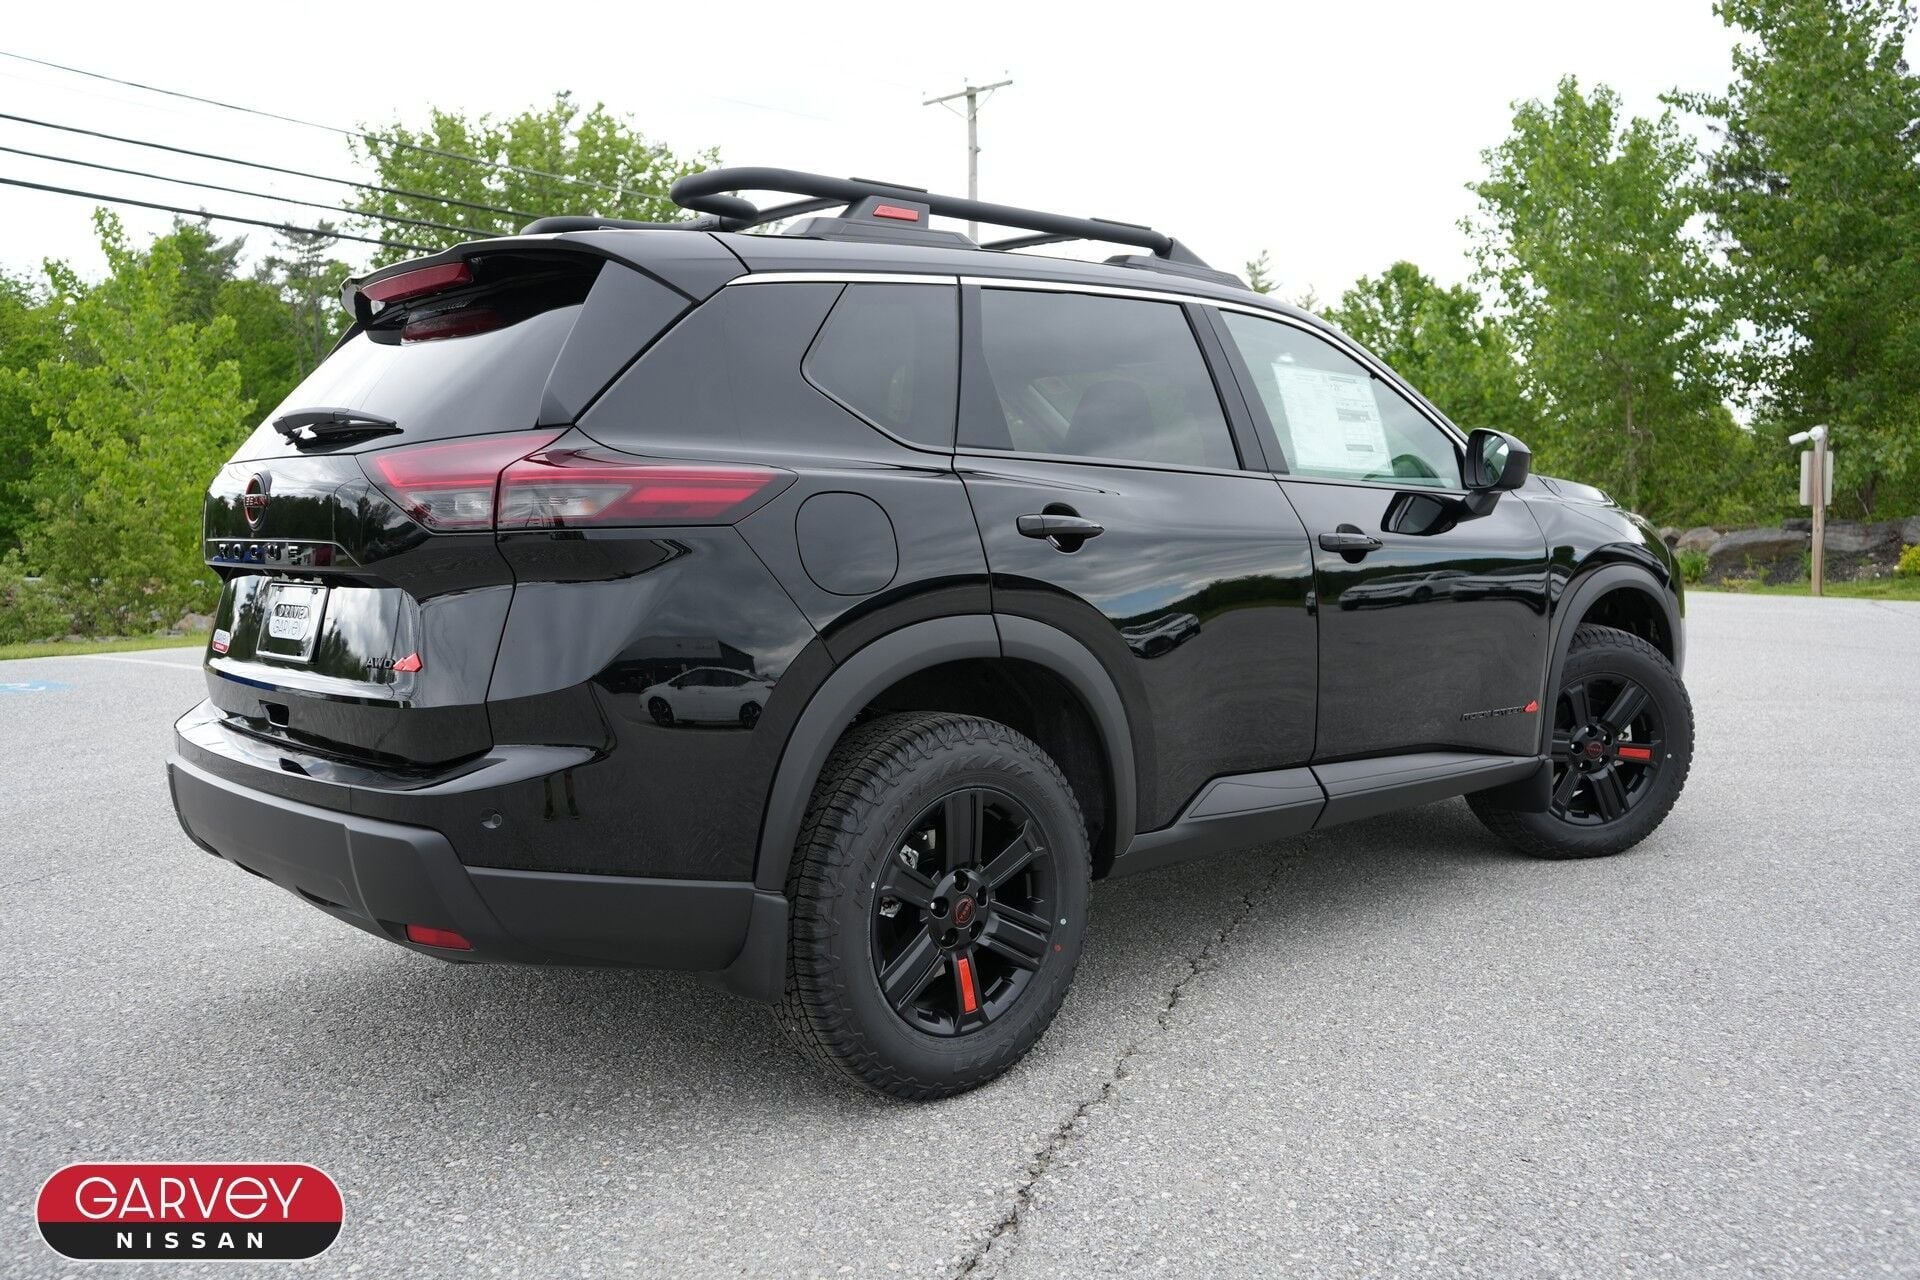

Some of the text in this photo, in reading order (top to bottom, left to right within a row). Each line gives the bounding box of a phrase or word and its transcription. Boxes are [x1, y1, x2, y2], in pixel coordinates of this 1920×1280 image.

[218, 543, 299, 560] ROGUE
[277, 604, 306, 620] DRIVE
[365, 656, 395, 669] AWD
